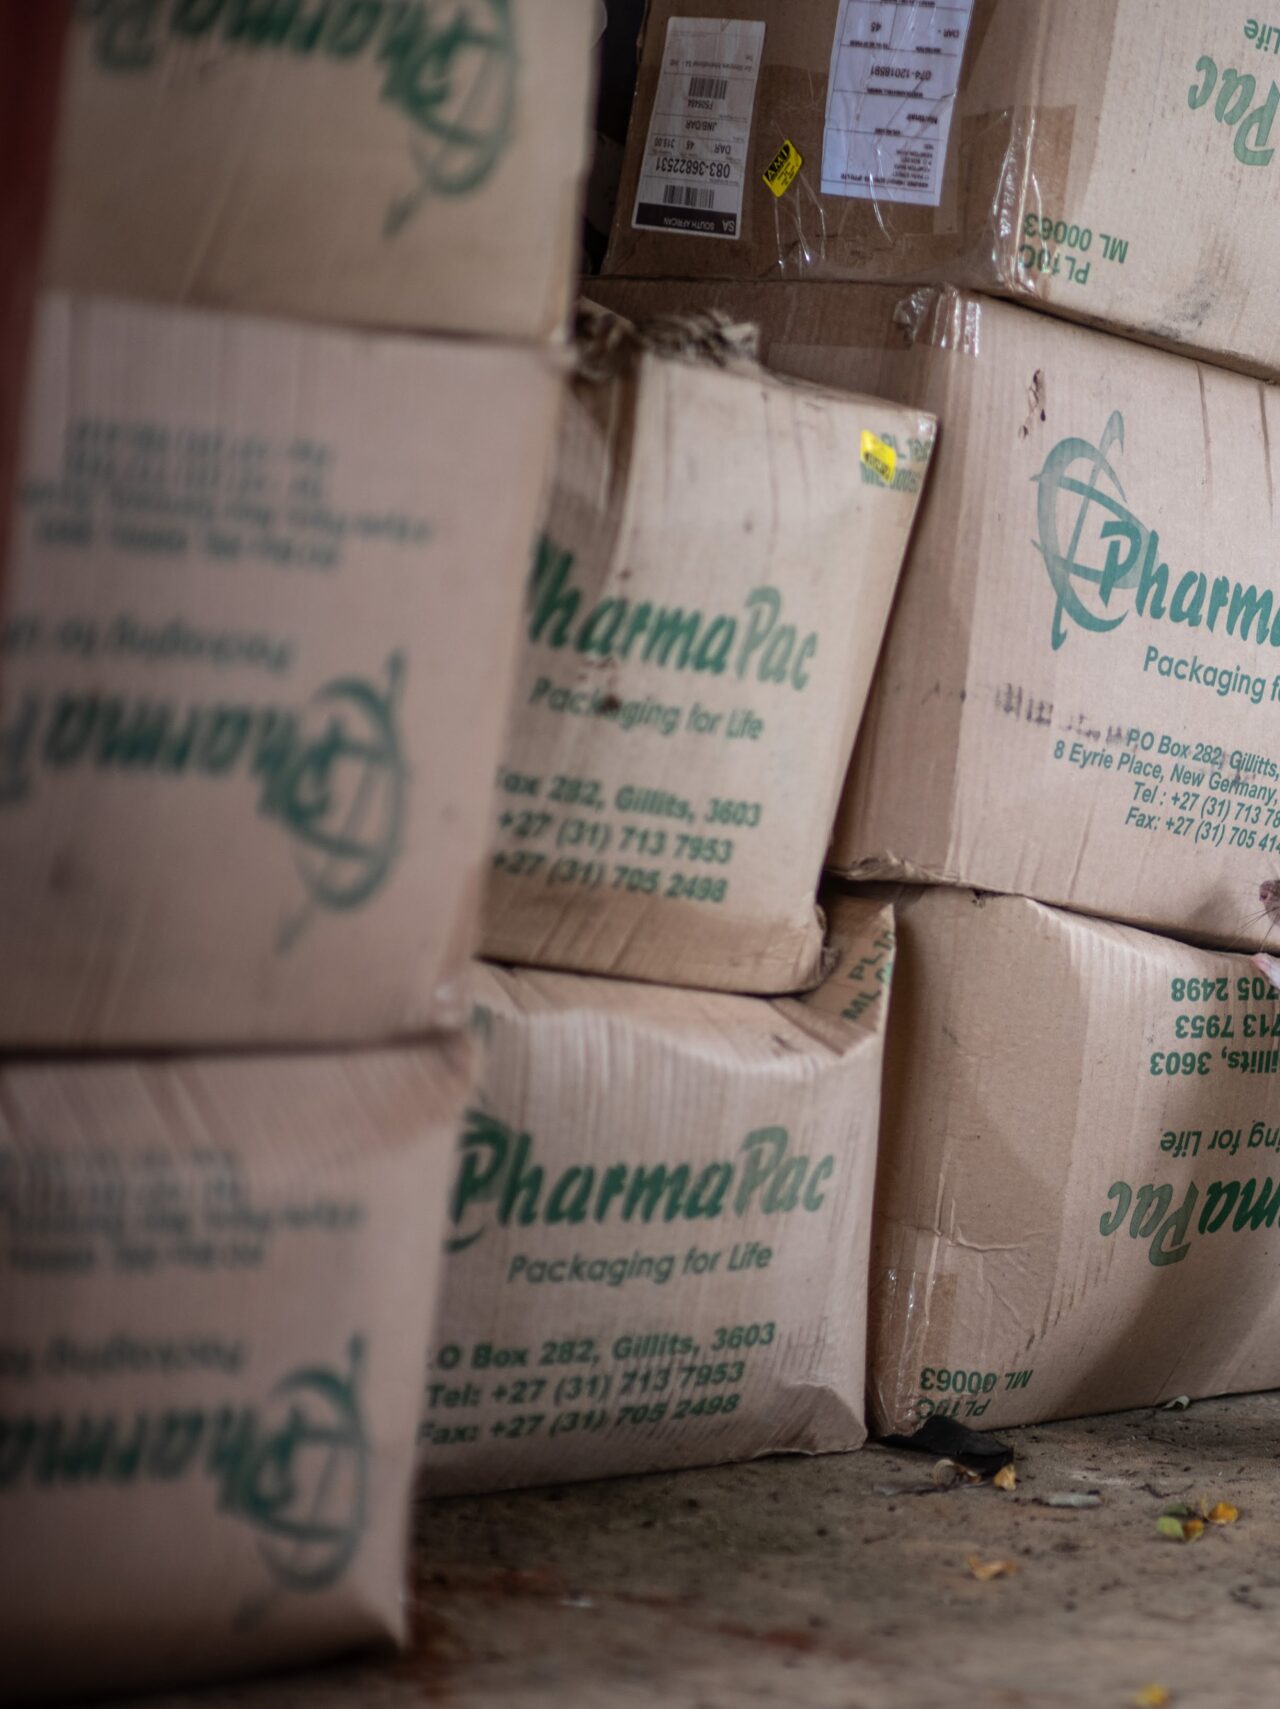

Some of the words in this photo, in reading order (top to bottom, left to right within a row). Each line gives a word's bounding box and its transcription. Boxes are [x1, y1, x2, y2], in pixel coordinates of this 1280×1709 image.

[656, 157, 731, 179] 083-36822531
[714, 144, 731, 155] DAR
[663, 216, 690, 229] AFRICAN
[692, 219, 715, 231] SOUTH
[722, 220, 736, 232] SA
[1023, 212, 1093, 252] 00063
[1099, 234, 1129, 264] ML
[528, 532, 818, 691] harmaPac
[1143, 645, 1264, 704] Packaging
[685, 701, 722, 735] for
[726, 706, 764, 740] Life
[1053, 740, 1064, 760] 8
[1068, 742, 1114, 773] Eyrie
[1116, 752, 1163, 782] Place,
[1170, 764, 1204, 788] New
[1208, 770, 1279, 807] Germany,
[1158, 735, 1191, 761] Box
[1193, 743, 1224, 768] 282,
[1229, 750, 1280, 780] Gillitts,
[497, 768, 541, 797] ox
[548, 774, 605, 810] 282,
[704, 798, 762, 828] 3603
[1170, 790, 1198, 812] +27
[1200, 795, 1230, 822] (31)
[1234, 803, 1261, 826] 713
[499, 810, 552, 838] +27
[557, 817, 611, 853] (31)
[618, 825, 668, 857] 713
[672, 834, 733, 865] 7953
[1125, 807, 1159, 831] Fax:
[1165, 816, 1194, 838] +27
[1195, 820, 1226, 848] (31)
[1229, 826, 1257, 850] 705
[492, 850, 547, 878] +27
[547, 857, 605, 890] (31)
[613, 866, 661, 894] 705
[665, 873, 728, 903] 2498
[1171, 976, 1229, 1002] 2498
[1175, 1014, 1235, 1040] 7953
[1150, 1051, 1209, 1077] 3603
[1160, 1130, 1200, 1158] Life
[1207, 1126, 1243, 1154] for
[448, 1126, 835, 1230] PharmaPac
[507, 1253, 674, 1287] Packaging
[681, 1244, 720, 1280] for
[727, 1241, 773, 1273] Life
[470, 1340, 528, 1370] Box
[540, 1338, 600, 1369] 282,
[711, 1321, 776, 1351] 3603
[427, 1382, 482, 1411] Tel:
[491, 1377, 546, 1406] +27
[554, 1370, 613, 1404] (31)
[620, 1367, 672, 1397] 713
[679, 1361, 746, 1390] 7953
[920, 1366, 997, 1395] 00063
[1004, 1369, 1033, 1391] ML
[490, 1412, 546, 1440] +27
[550, 1406, 608, 1438] (31)
[614, 1399, 666, 1427] 705
[671, 1393, 740, 1422] 2498
